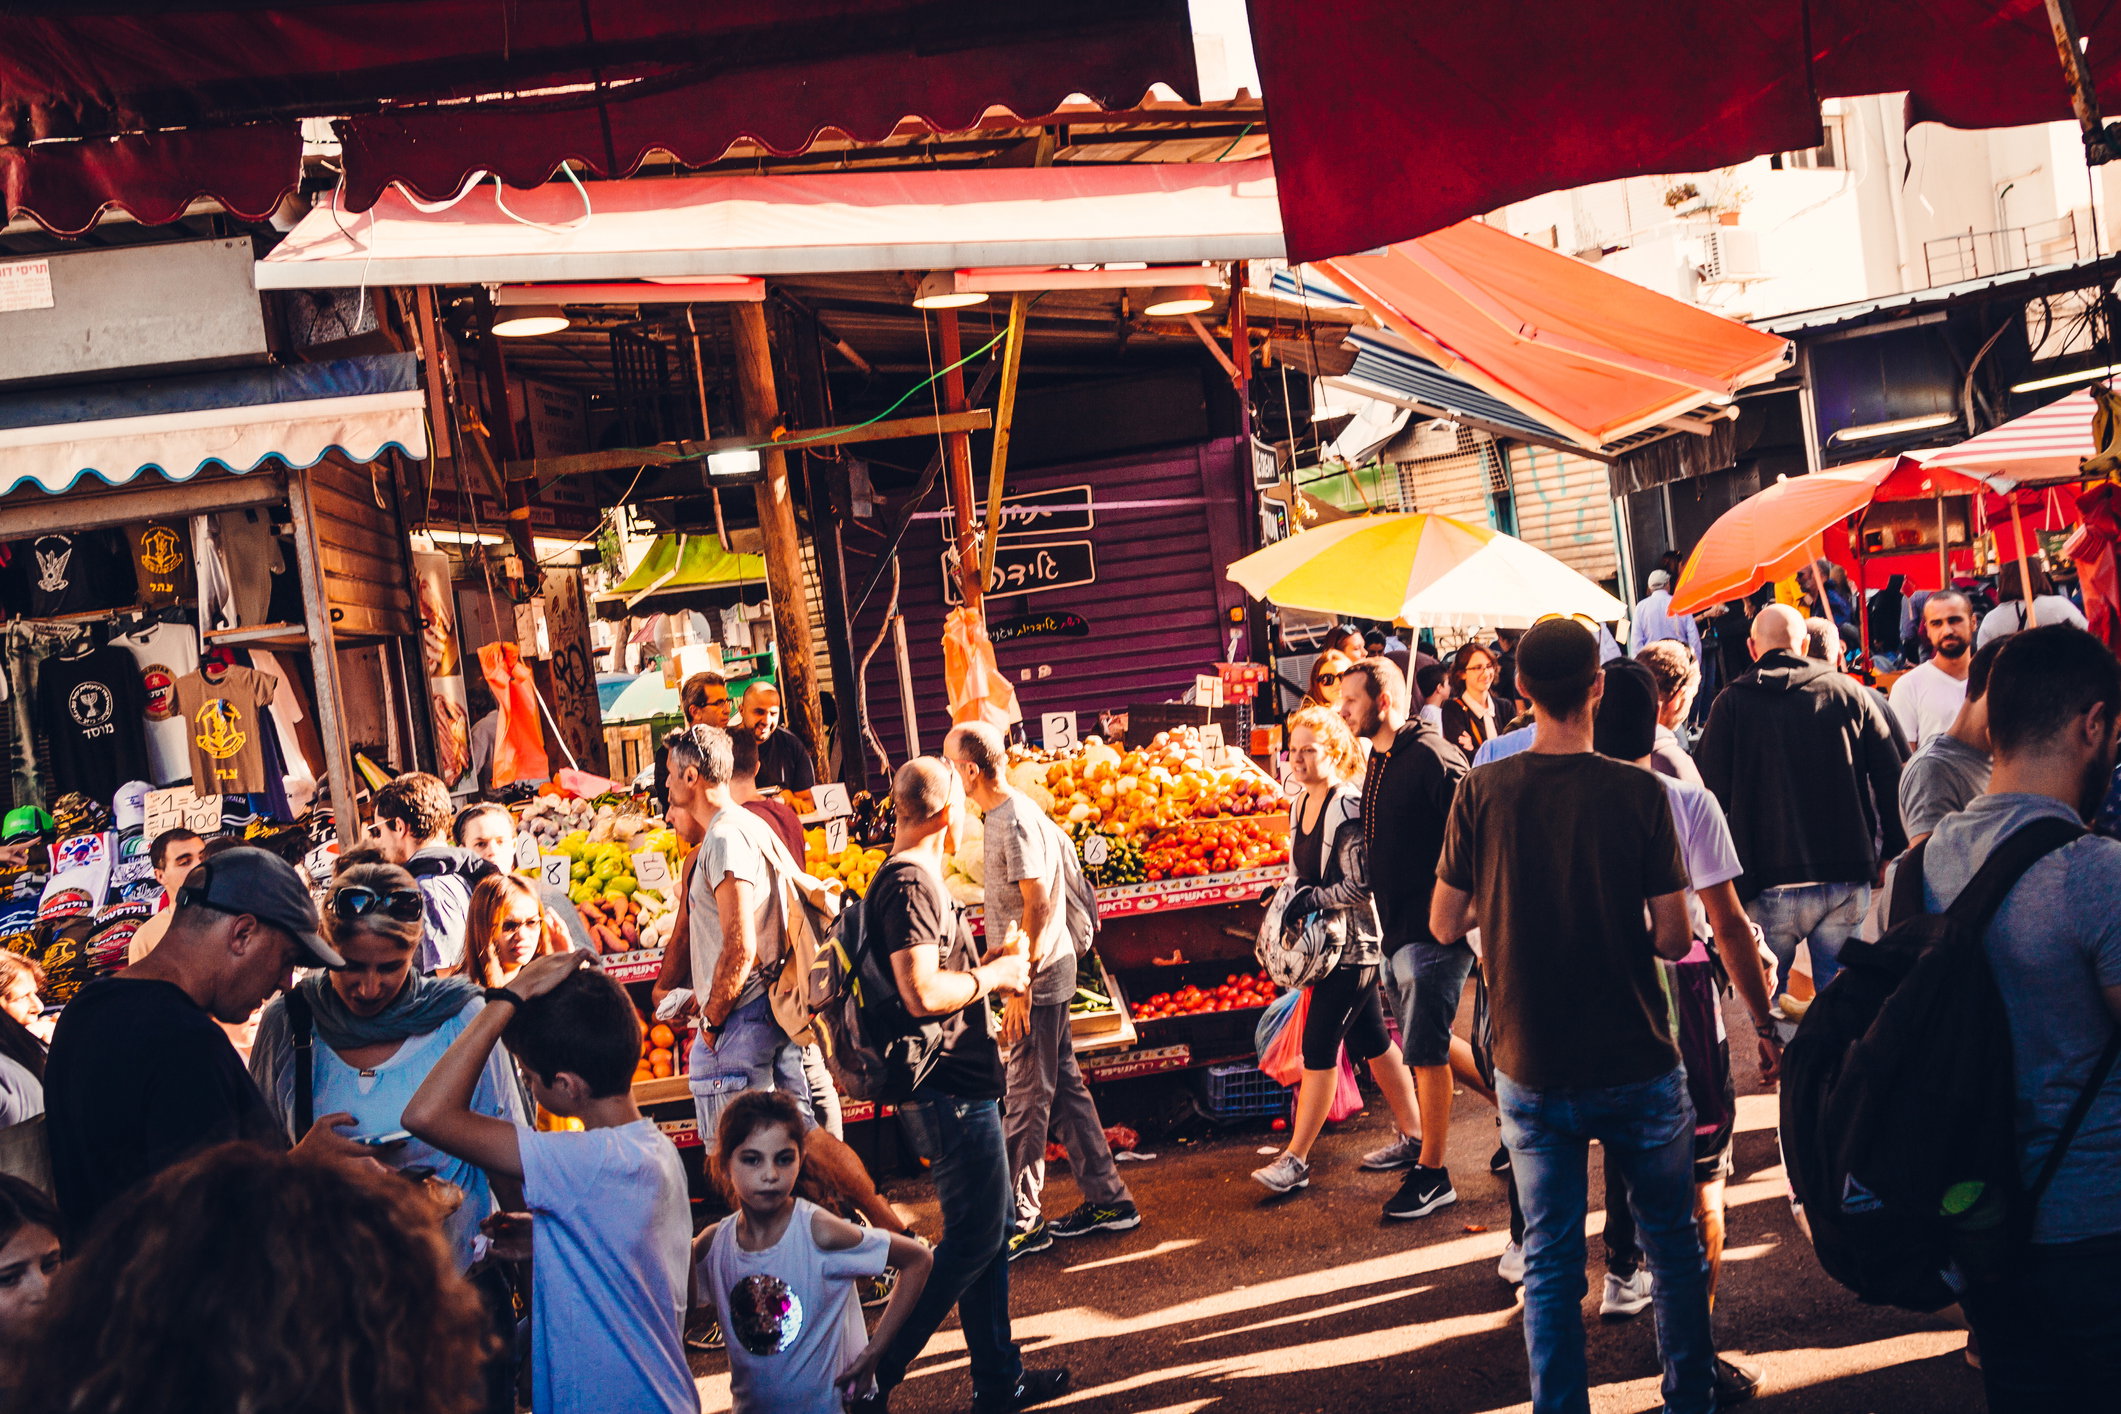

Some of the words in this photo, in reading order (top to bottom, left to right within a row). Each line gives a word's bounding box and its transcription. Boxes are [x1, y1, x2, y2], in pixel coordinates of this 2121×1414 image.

[0, 267, 12, 277] דו
[16, 264, 47, 275] תריסי
[990, 551, 1059, 590] גלידה
[1201, 679, 1215, 704] 4
[82, 723, 114, 739] מוסד
[1051, 716, 1070, 748] 3
[1205, 735, 1219, 762] 7
[823, 788, 839, 812] 6
[830, 821, 842, 851] 7
[520, 838, 535, 865] 6
[546, 861, 562, 885] 8
[640, 858, 665, 882] 5
